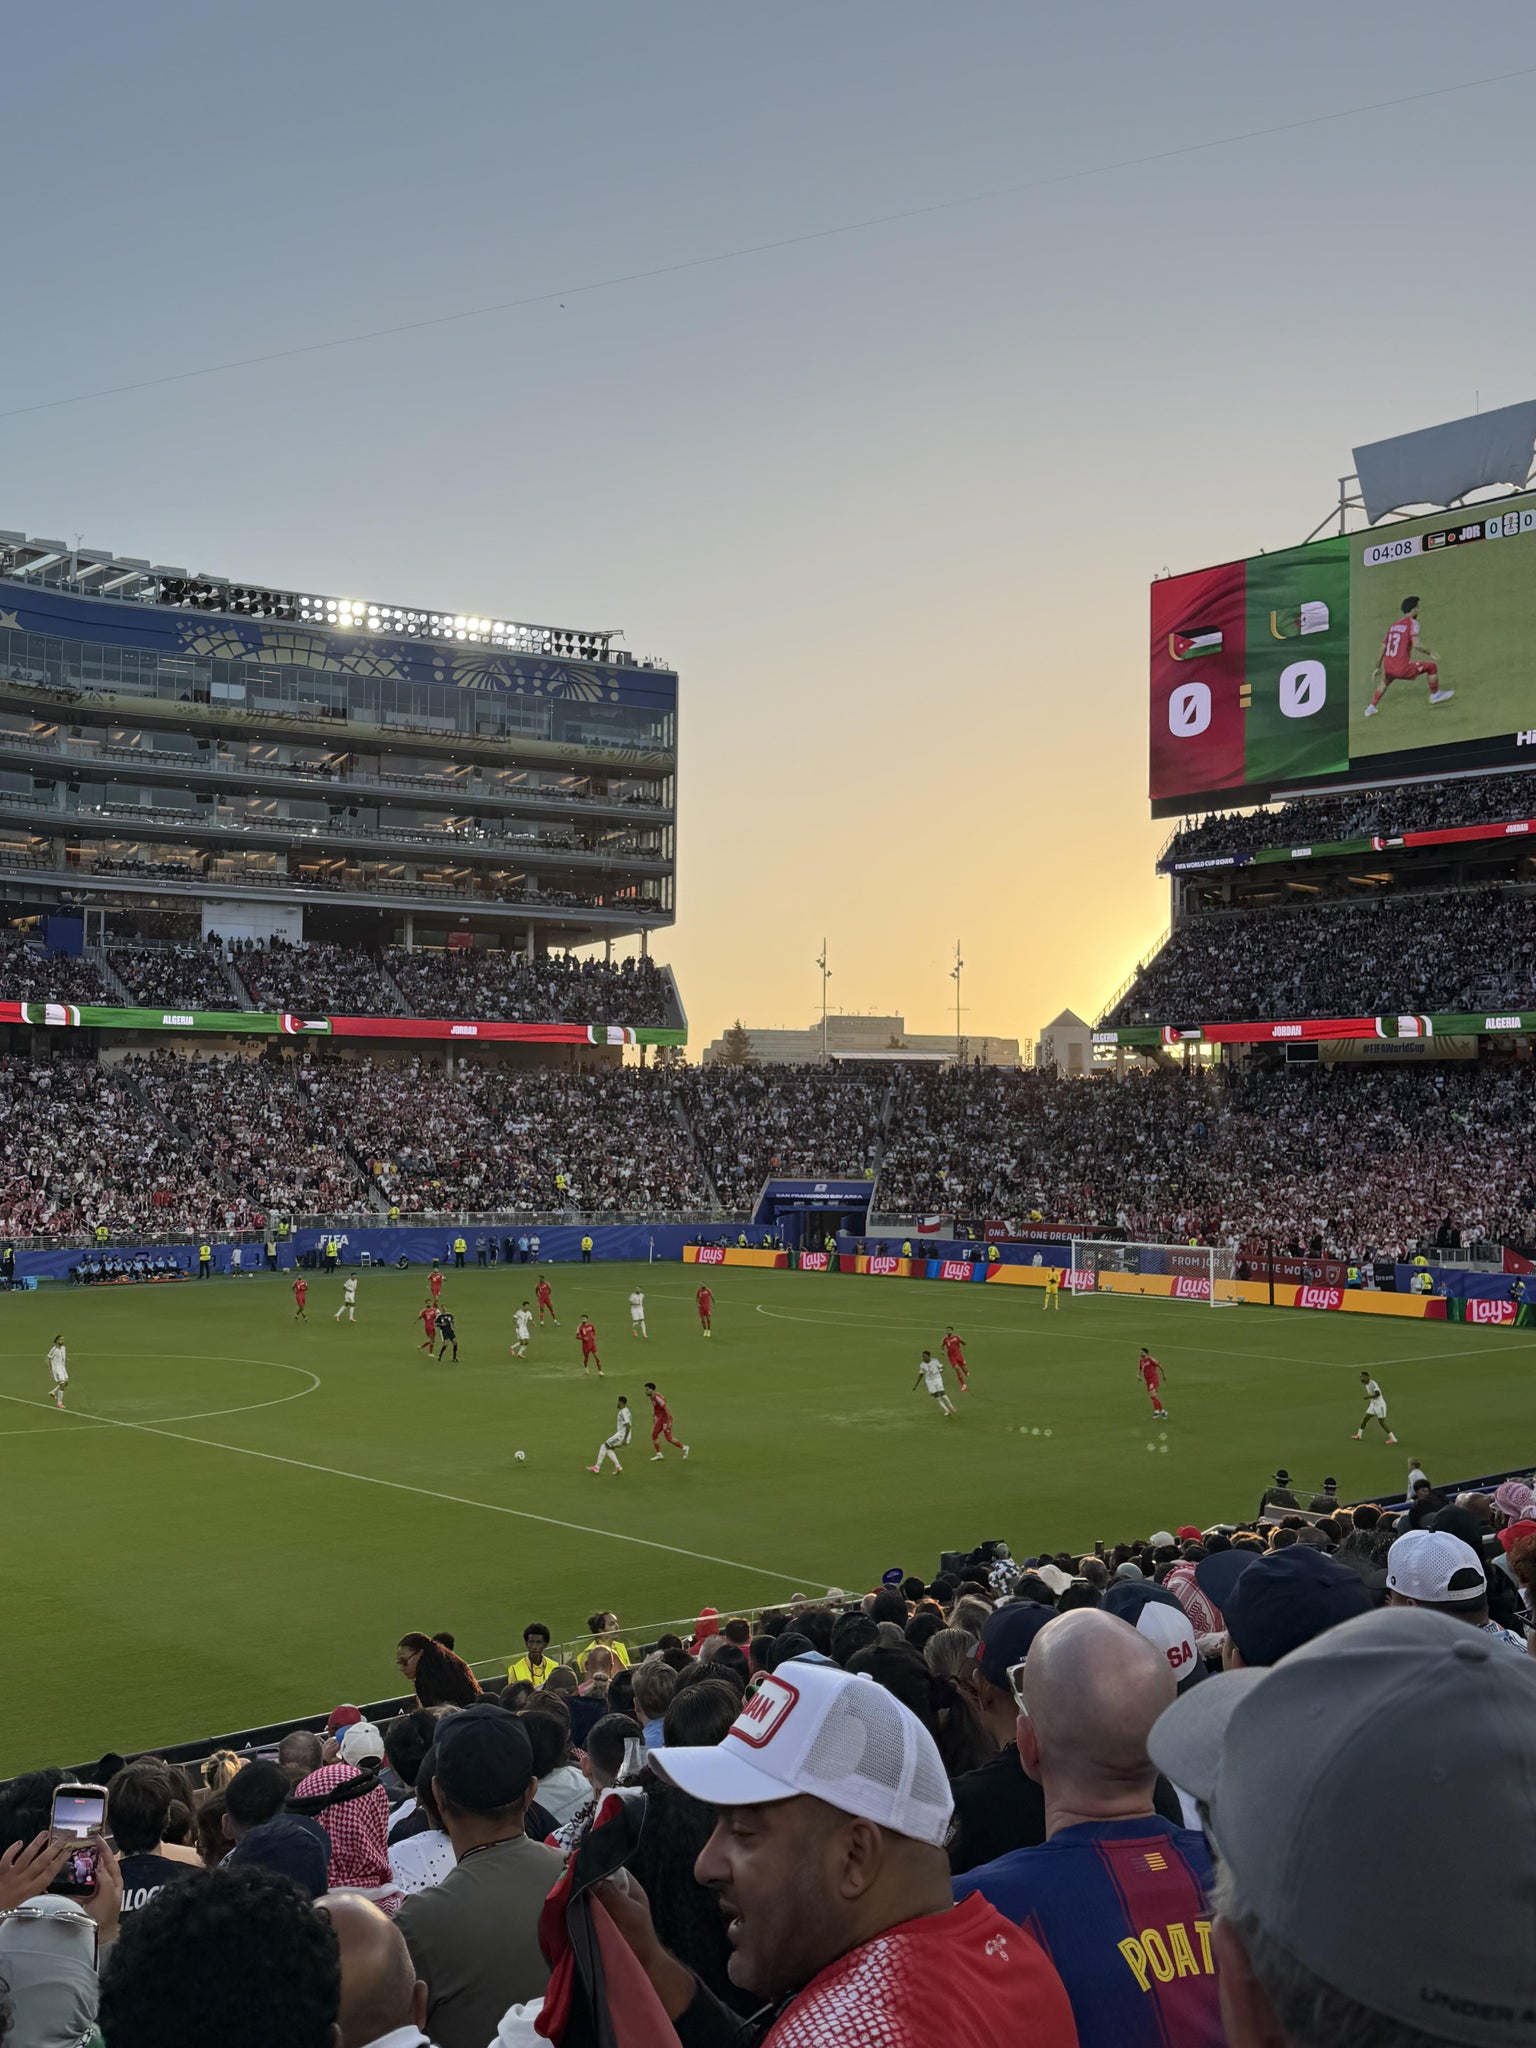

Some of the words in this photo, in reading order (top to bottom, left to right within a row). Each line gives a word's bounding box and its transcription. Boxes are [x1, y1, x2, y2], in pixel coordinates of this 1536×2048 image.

[1372, 541, 1412, 562] 04:08
[1459, 525, 1481, 541] JOR
[1490, 522, 1498, 534] 0
[1524, 514, 1533, 527] 0
[162, 1014, 194, 1026] ALGERIA
[1485, 1016, 1521, 1029] ALGERIA
[450, 1025, 478, 1036] JORDAN
[1092, 1032, 1119, 1043] ALGERIA
[1271, 1025, 1302, 1037] JORDAN
[320, 1234, 349, 1246] FIFA
[988, 1228, 1006, 1237] ONE
[1030, 1230, 1048, 1239] ONE
[1049, 1231, 1080, 1240] DREAM
[699, 1246, 724, 1264] Lay's
[802, 1252, 827, 1270] Lays
[1171, 1256, 1200, 1267] FROM
[870, 1256, 897, 1275] Lays
[943, 1259, 970, 1280] Lay's
[1175, 1276, 1211, 1299] Lay's
[1301, 1286, 1339, 1309] Lay's
[1166, 1640, 1193, 1669] SA
